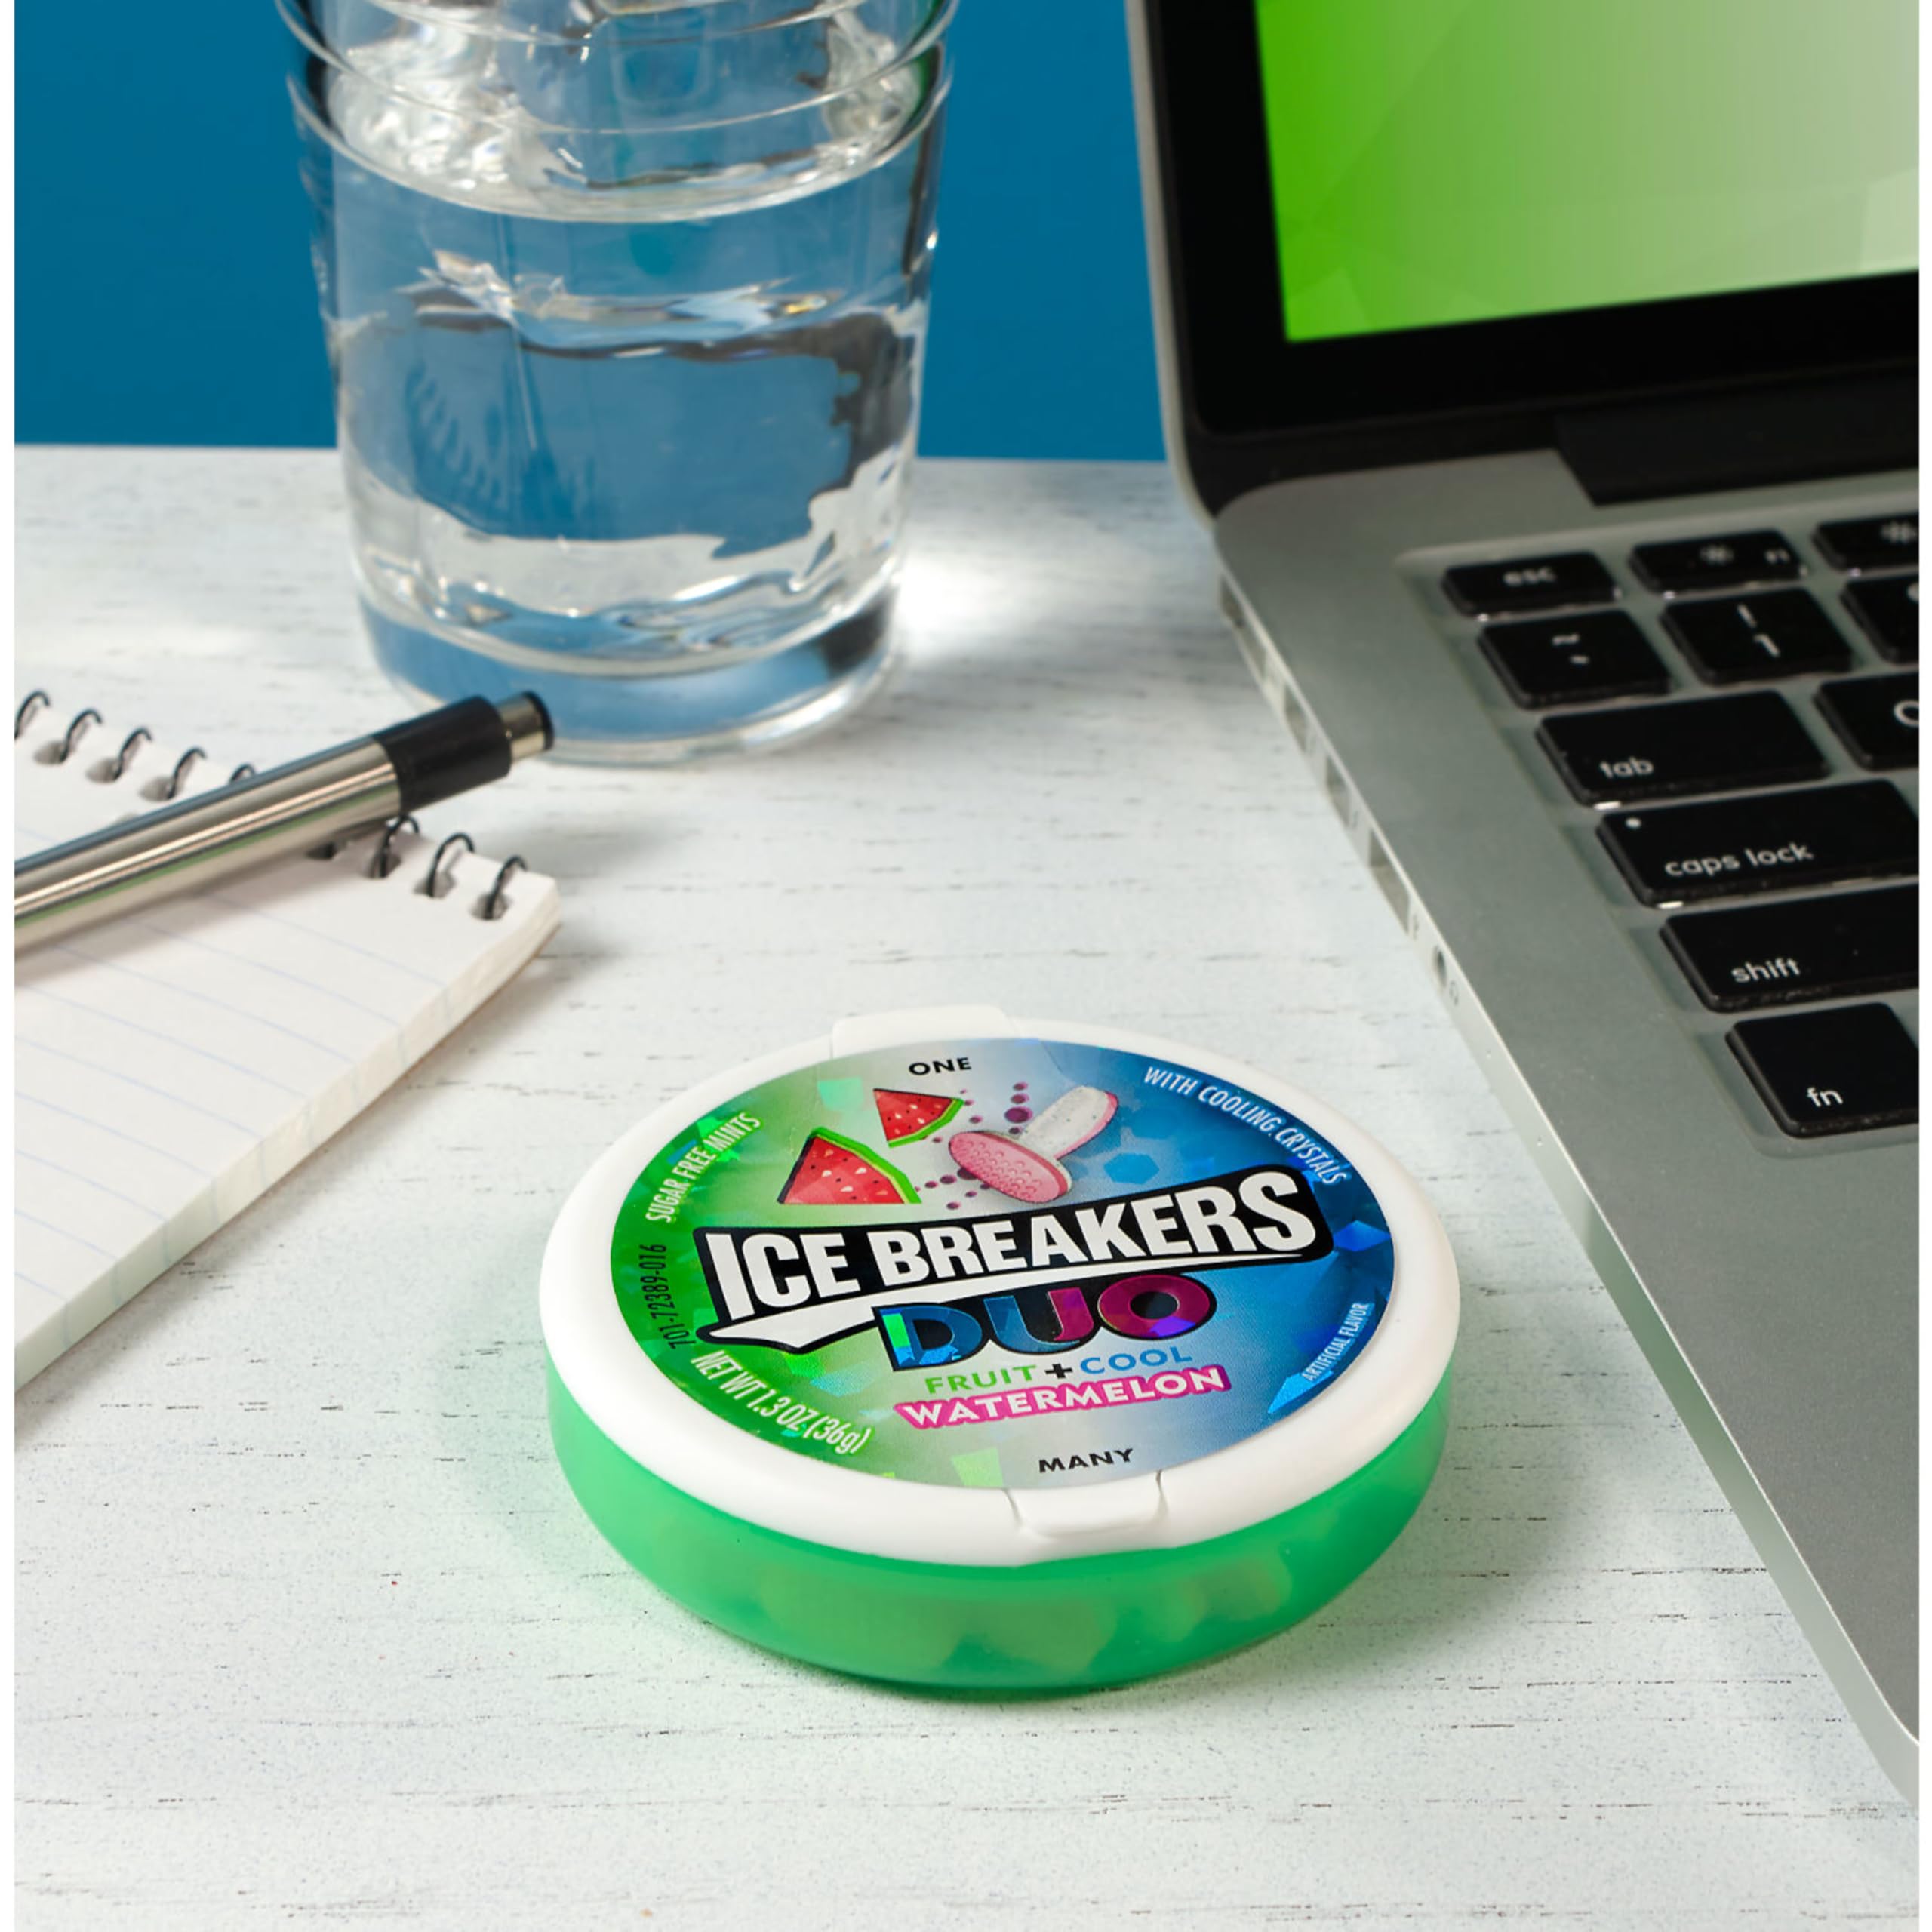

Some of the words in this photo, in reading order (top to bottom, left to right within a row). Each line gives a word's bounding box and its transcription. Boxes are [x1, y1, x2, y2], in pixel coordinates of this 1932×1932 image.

[1503, 566, 1556, 586] esc
[1599, 756, 1654, 780] tab
[1665, 851, 1740, 878] caps
[1744, 841, 1814, 867] lock
[1730, 956, 1801, 983] shift
[908, 1057, 972, 1076] ONE
[1806, 1085, 1844, 1108] fn
[1143, 1066, 1199, 1095] WITH
[1197, 1085, 1282, 1133] COOLING
[1274, 1127, 1348, 1185] CRYSTALS
[645, 1177, 691, 1223] SUGAR
[672, 1146, 717, 1180] FREE
[701, 1112, 761, 1152] MINTS
[705, 1232, 861, 1321] ICE
[866, 1171, 1316, 1288] BREAKERS
[638, 1244, 697, 1349] 701-72389-016
[878, 1273, 1212, 1369] DUO
[924, 1364, 1037, 1395] FRUIT
[1079, 1345, 1193, 1375] COOL
[1301, 1337, 1352, 1382] ARTIFICIAL
[1337, 1302, 1371, 1337] FLAVOR
[690, 1349, 743, 1380] NET
[718, 1371, 768, 1401] WT
[746, 1388, 792, 1417] 1.3
[775, 1404, 820, 1432] OZ
[802, 1415, 872, 1455] (36g)
[903, 1367, 1228, 1429] WATERMELON
[1038, 1447, 1134, 1473] MANY
